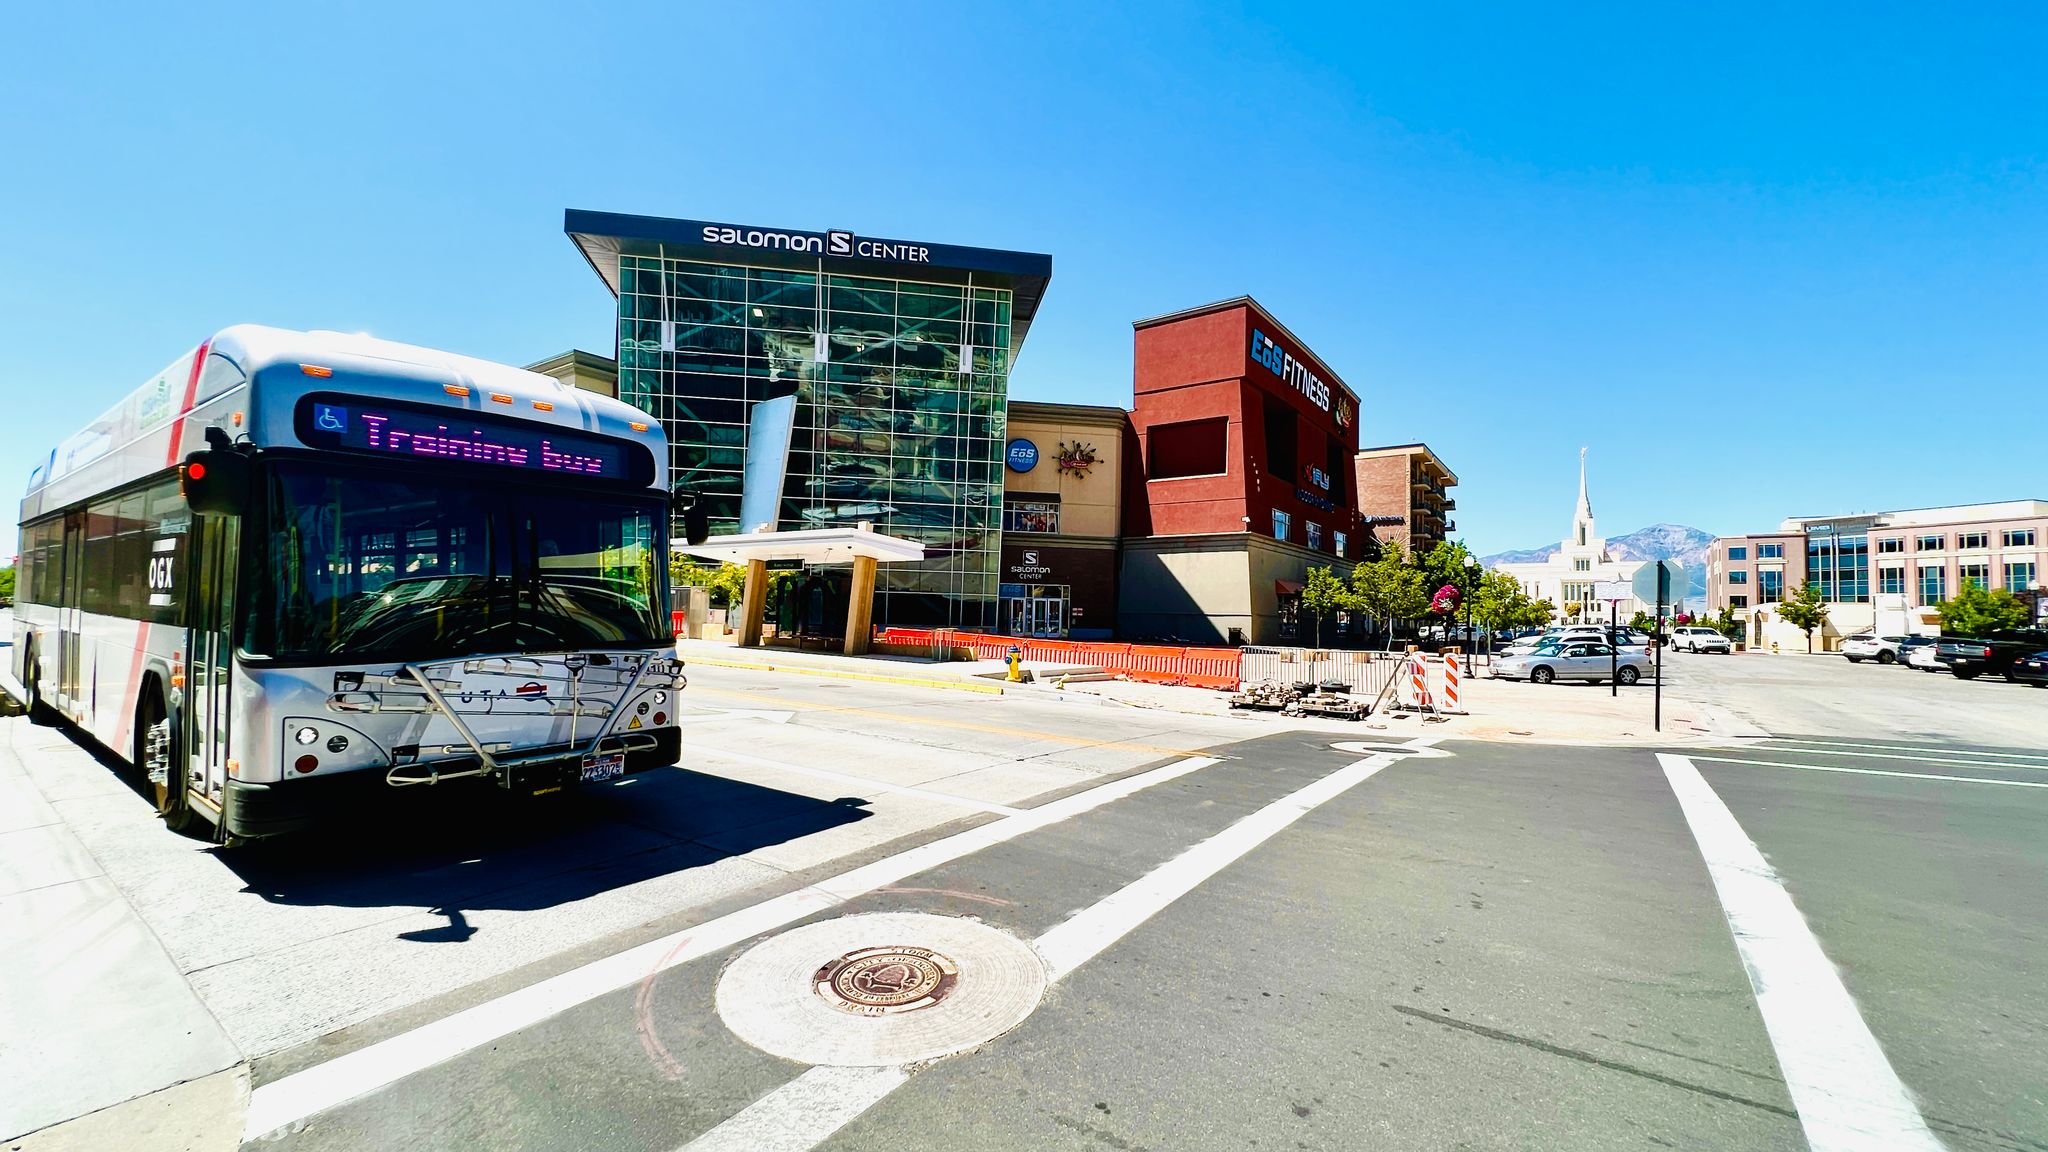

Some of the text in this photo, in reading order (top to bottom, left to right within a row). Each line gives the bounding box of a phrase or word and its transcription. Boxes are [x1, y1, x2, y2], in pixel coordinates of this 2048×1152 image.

[857, 240, 930, 262] CENTER
[1282, 352, 1330, 412] FITNESS
[149, 557, 174, 589] OGX
[461, 688, 507, 703] UTA
[838, 1001, 885, 1013] DRAIN
